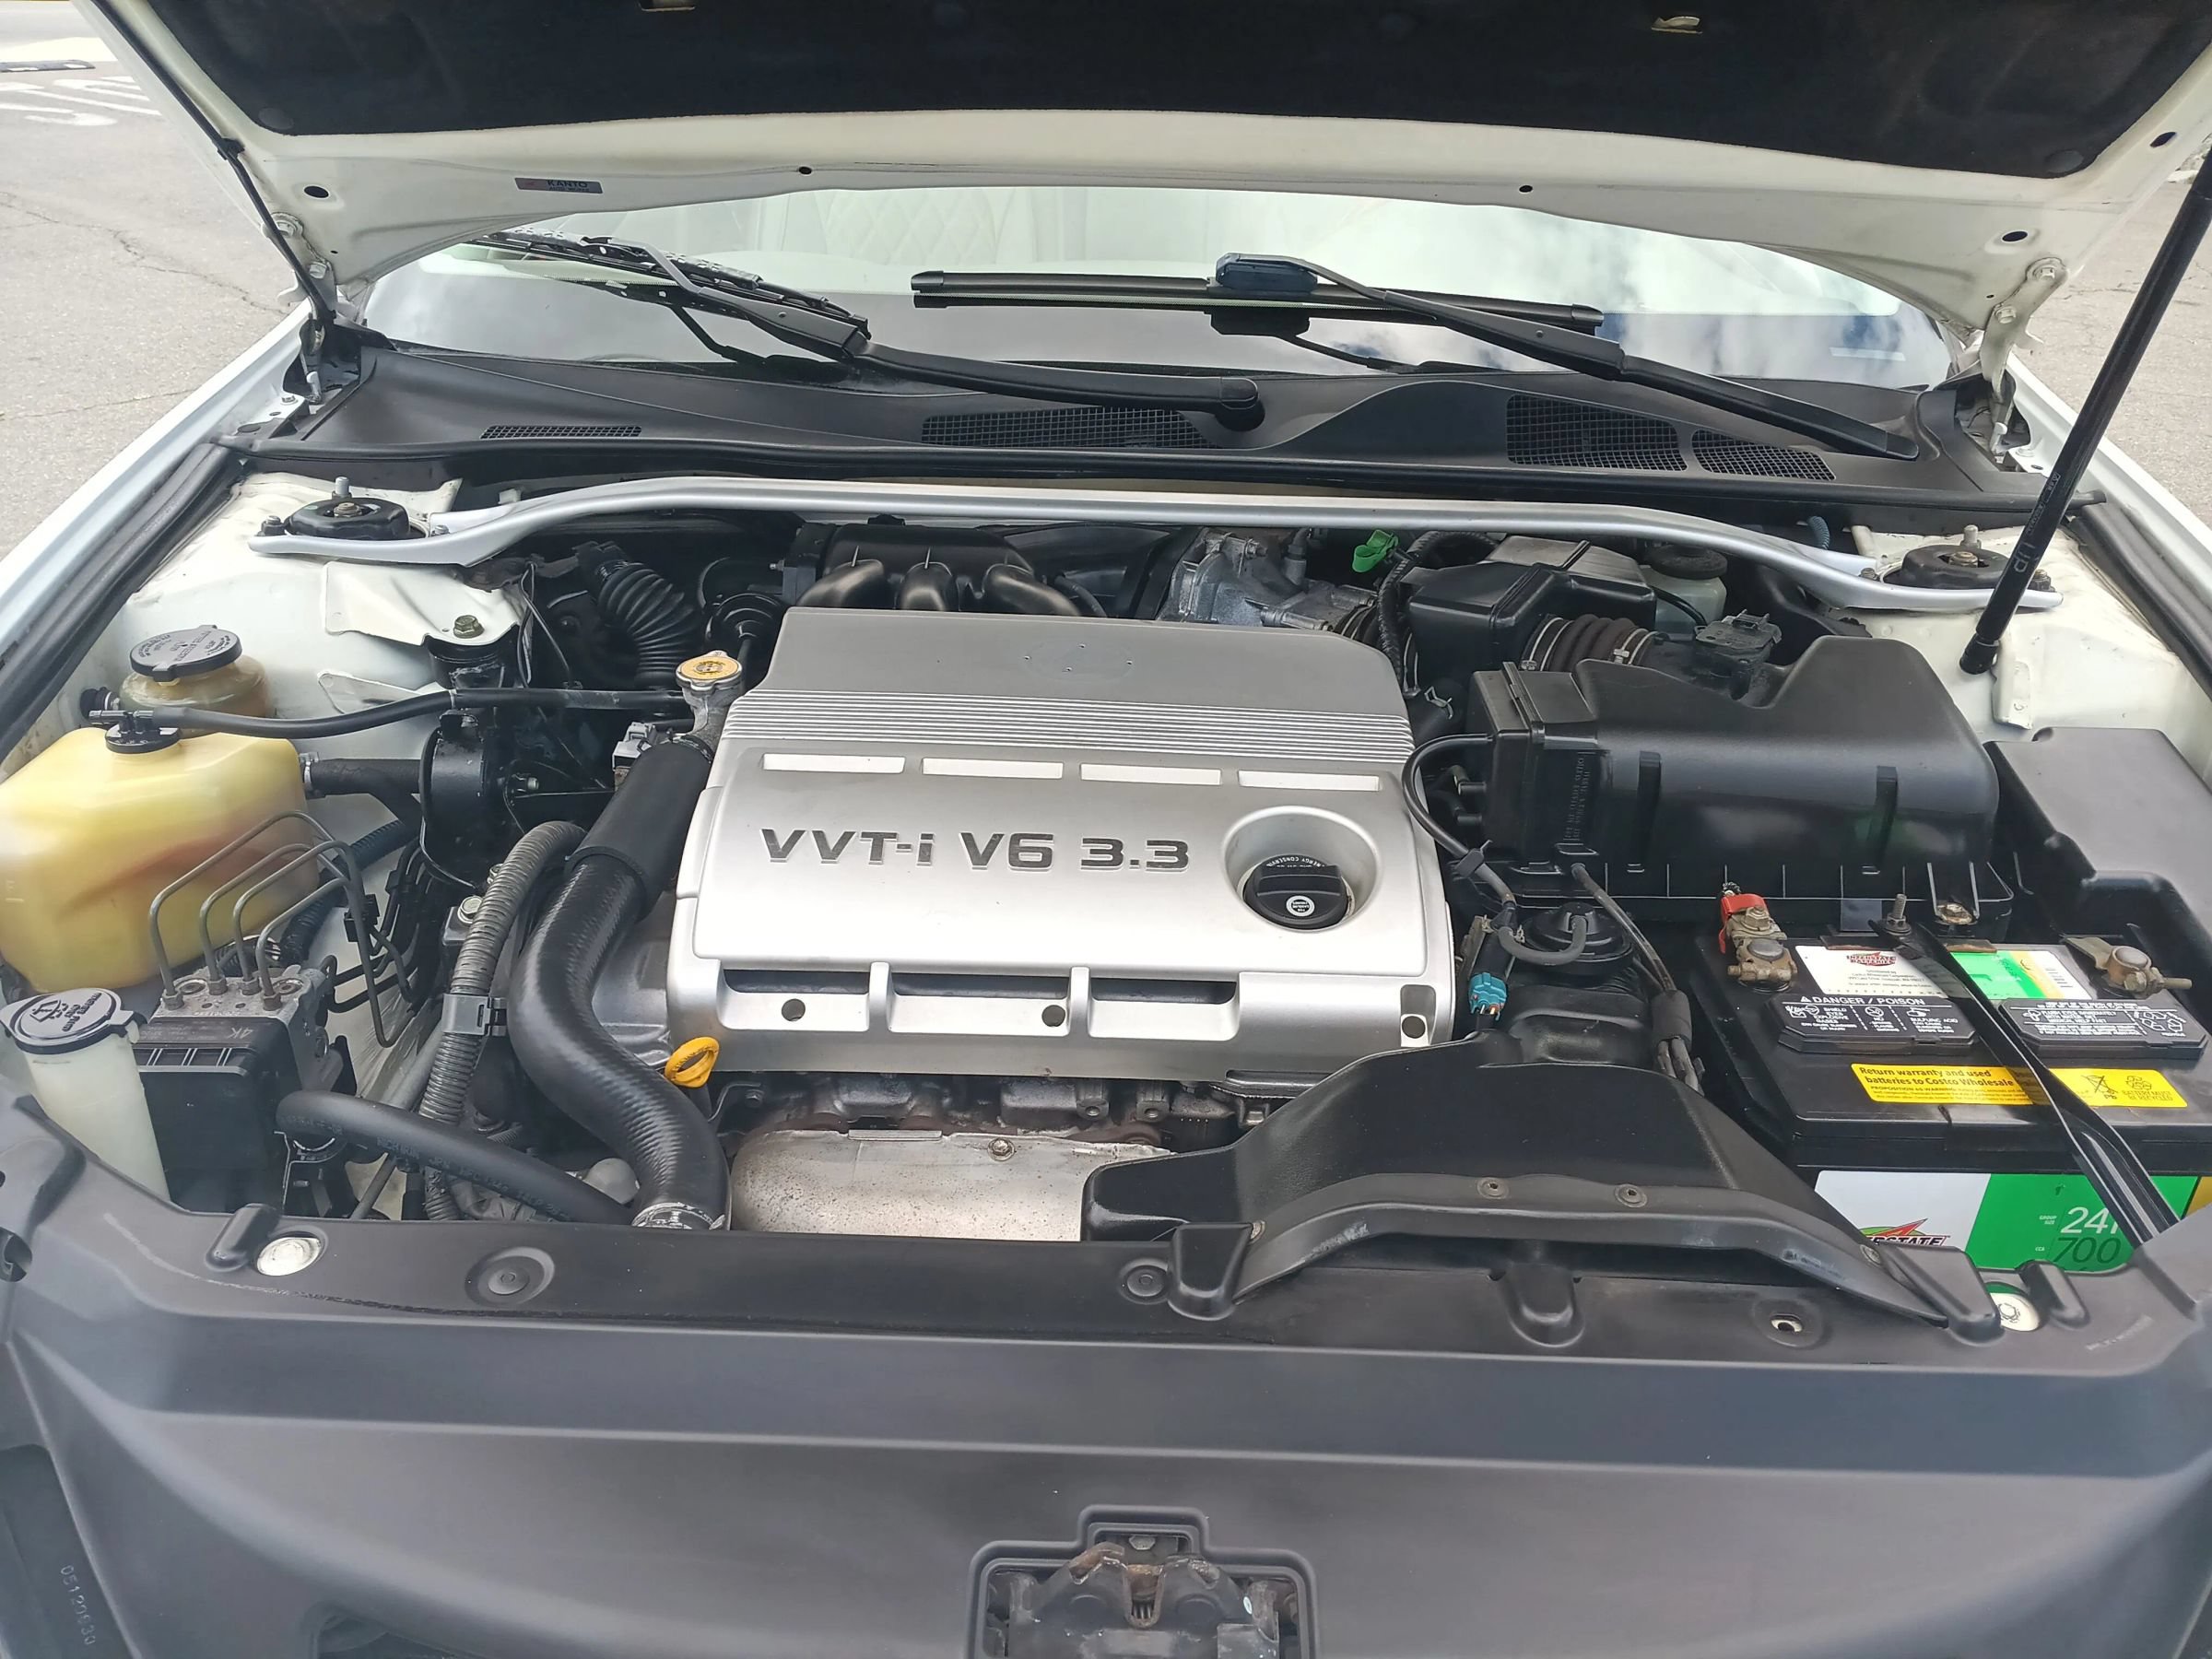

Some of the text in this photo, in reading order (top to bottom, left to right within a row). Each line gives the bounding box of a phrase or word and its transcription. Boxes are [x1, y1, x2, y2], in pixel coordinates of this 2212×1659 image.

[547, 180, 588, 188] KANTO
[761, 829, 1190, 872] VVT-i V6 3.3
[1301, 857, 1324, 867] NERGY
[1812, 996, 1865, 1005] DANGER
[228, 1027, 254, 1040] 4K
[1859, 1067, 1895, 1077] Return
[1896, 1069, 1943, 1077] warranty
[1865, 1077, 1912, 1085] batteries
[2053, 1237, 2122, 1264] 700
